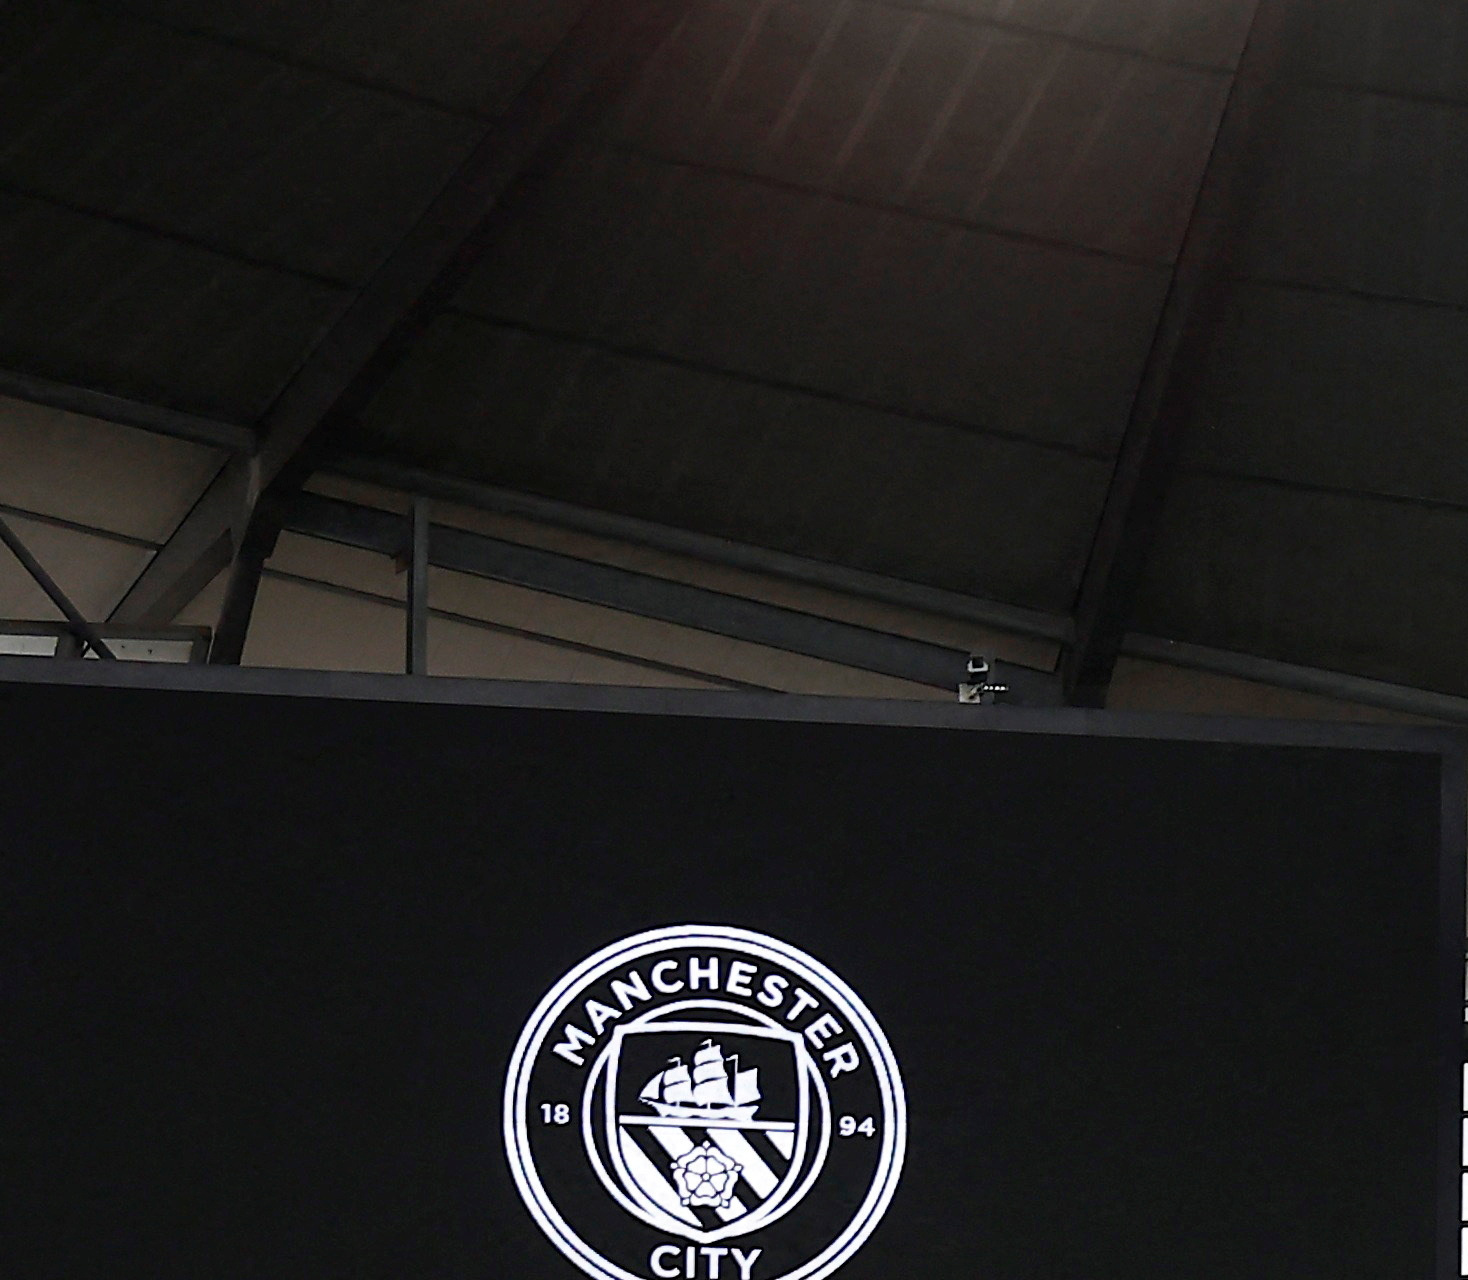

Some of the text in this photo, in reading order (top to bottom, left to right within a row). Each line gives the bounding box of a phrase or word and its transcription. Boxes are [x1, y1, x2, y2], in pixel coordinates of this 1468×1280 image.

[552, 956, 861, 1079] MANCHESTER
[540, 1103, 570, 1125] 18
[838, 1116, 876, 1137] 94
